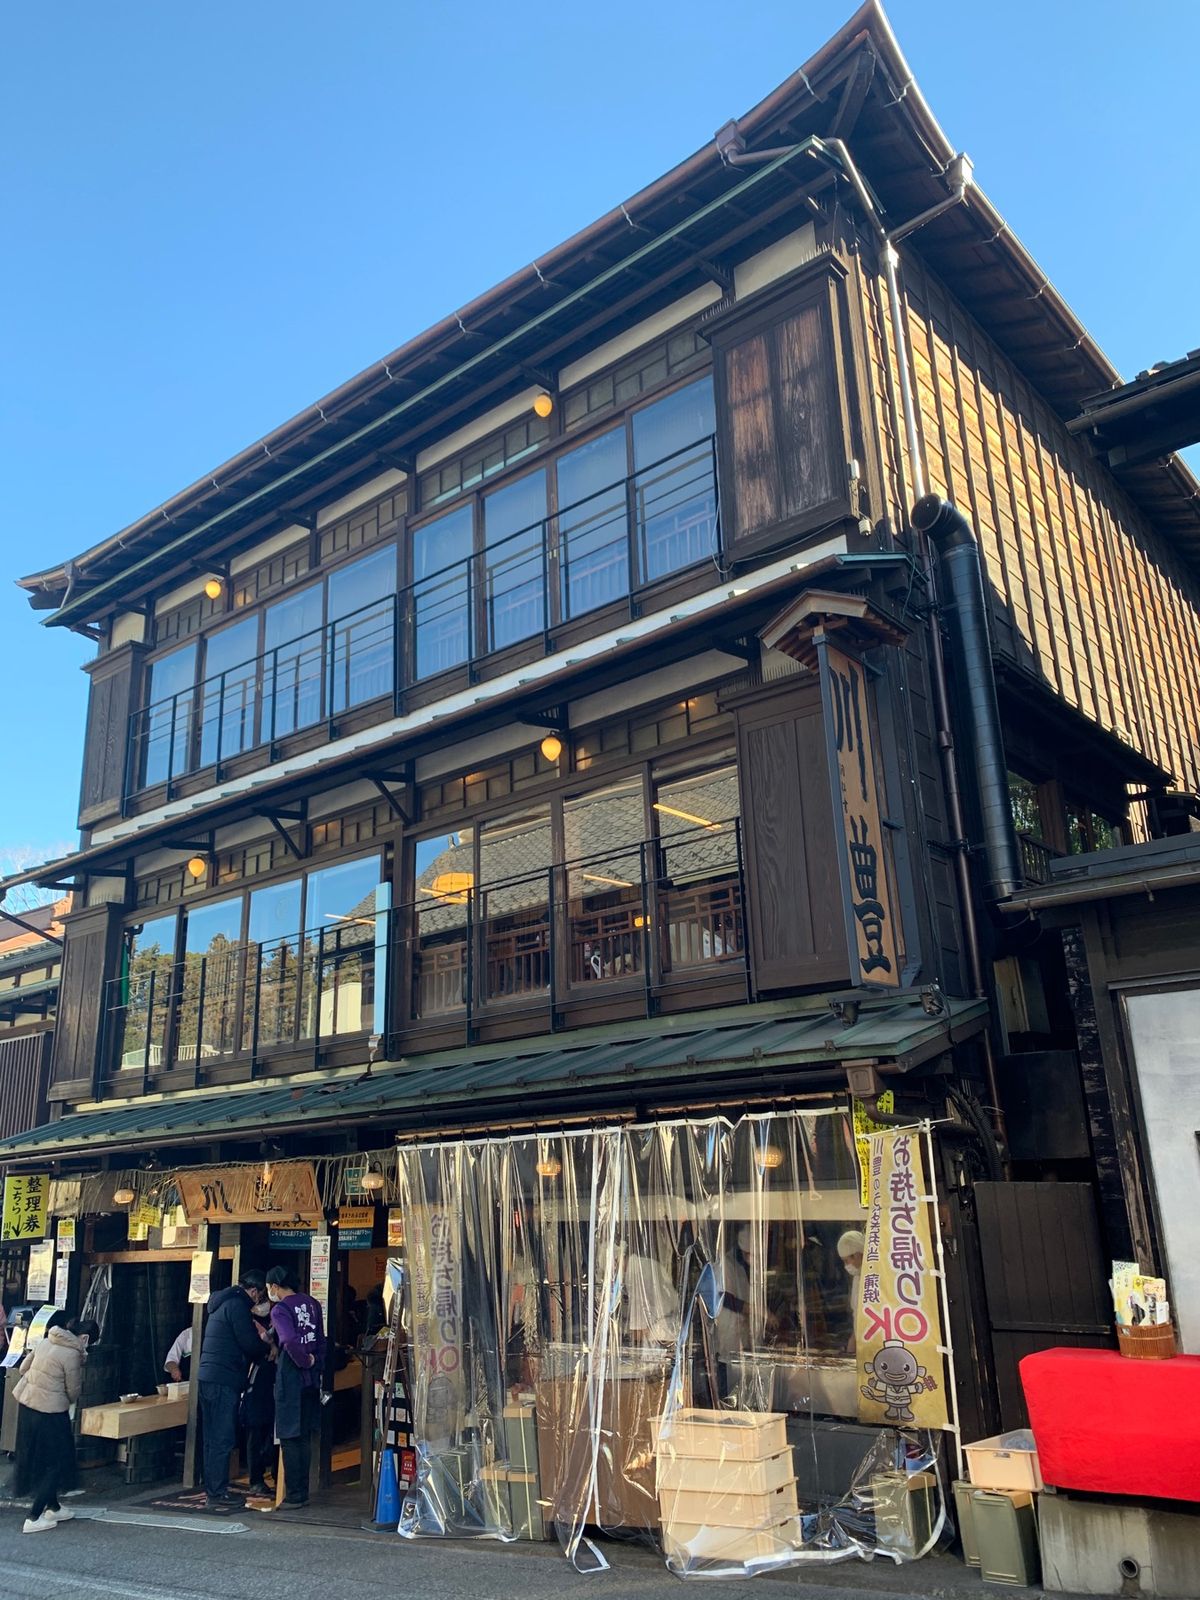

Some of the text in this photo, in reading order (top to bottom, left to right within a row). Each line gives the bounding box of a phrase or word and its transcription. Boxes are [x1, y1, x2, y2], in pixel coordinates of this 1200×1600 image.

[12, 1179, 22, 1214] こちら
[23, 1175, 42, 1232] 整理券
